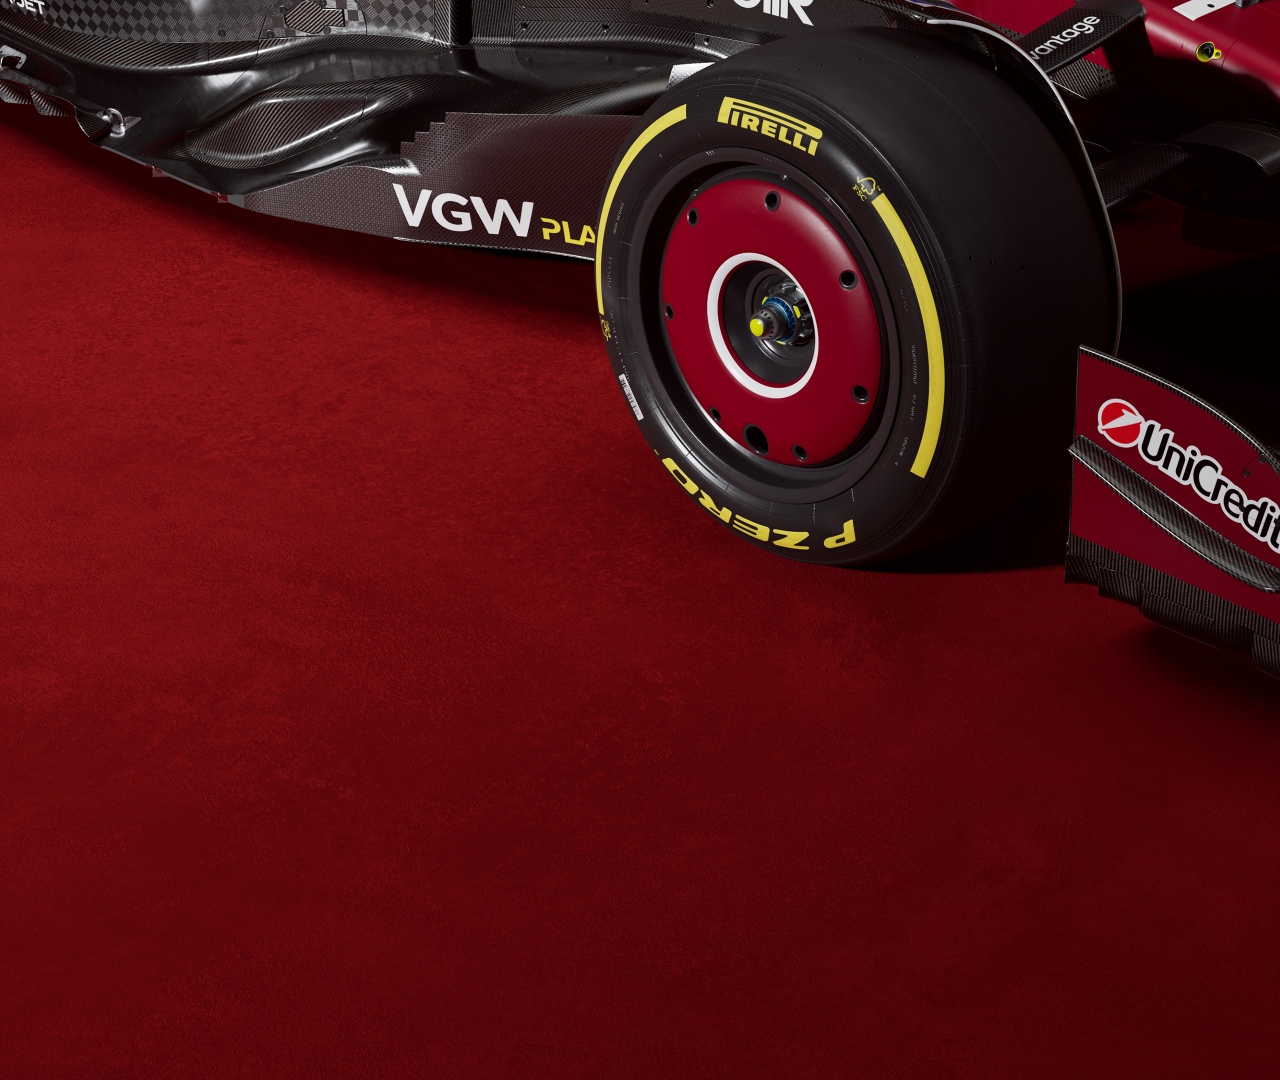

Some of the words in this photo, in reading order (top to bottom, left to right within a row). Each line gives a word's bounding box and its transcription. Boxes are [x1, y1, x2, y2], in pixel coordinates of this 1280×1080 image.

[1028, 12, 1101, 62] vantage
[717, 96, 823, 156] PIRELLI
[392, 182, 534, 238] VGW
[540, 217, 597, 247] PLA
[661, 457, 810, 550] ZERO
[823, 518, 856, 549] P
